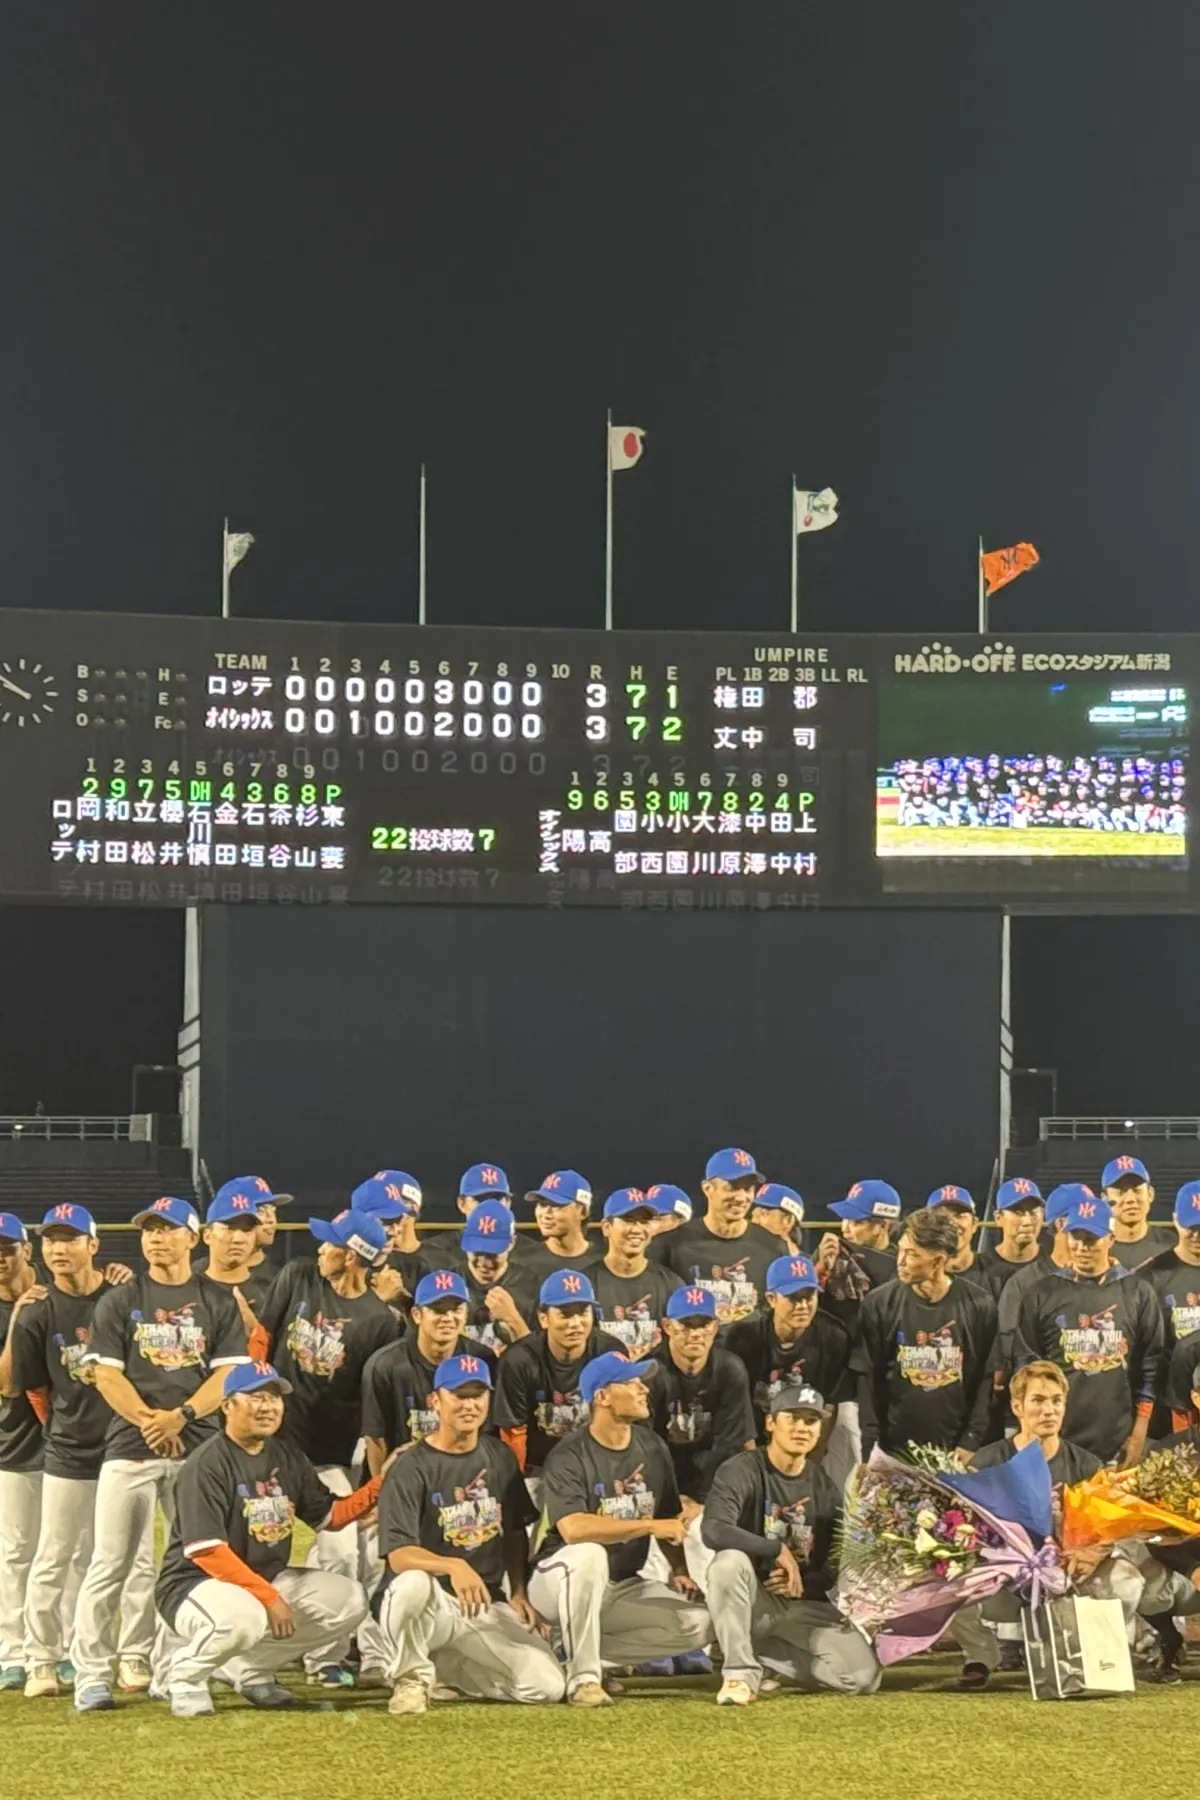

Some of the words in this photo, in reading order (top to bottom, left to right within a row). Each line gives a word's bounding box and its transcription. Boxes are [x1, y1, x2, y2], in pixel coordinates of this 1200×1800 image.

[215, 654, 267, 670] TEAM
[754, 648, 828, 662] UMPIRE
[1021, 653, 1171, 672] ECOスタジアム新潟
[77, 665, 88, 678] B
[158, 668, 170, 681] H
[291, 657, 300, 672] 1
[320, 658, 331, 672] 2
[351, 658, 361, 673] 3
[380, 660, 391, 674] 4
[409, 660, 420, 675] 5
[438, 661, 450, 675] 6
[468, 662, 479, 677] 7
[497, 663, 508, 677] 8
[526, 663, 537, 678] 9
[551, 664, 570, 678] 10
[590, 665, 602, 680] R
[631, 665, 642, 680] H
[667, 666, 678, 680] E
[716, 666, 736, 680] PL
[744, 667, 762, 680] 1B
[768, 667, 790, 681] 2B
[795, 668, 815, 682] 3B
[822, 668, 840, 682] LL
[847, 668, 868, 682] RL
[77, 689, 88, 702] S
[158, 692, 169, 705] E
[208, 676, 272, 696] ロッテ
[286, 676, 306, 700] 0
[315, 676, 335, 701] 0
[346, 678, 366, 702] 0
[375, 678, 395, 703] 0
[404, 678, 424, 704] 0
[434, 680, 454, 704] 3
[463, 680, 484, 705] 0
[492, 681, 512, 706] 0
[522, 682, 542, 706] 0
[586, 684, 606, 708] 3
[626, 684, 646, 708] 7
[668, 684, 677, 708] 1
[155, 716, 172, 729] Fc
[285, 708, 305, 732] 0
[315, 709, 334, 734] 0
[350, 710, 360, 734] 1
[375, 710, 395, 735] 0
[404, 711, 424, 736] 0
[434, 712, 454, 736] 2
[463, 712, 483, 737] 0
[492, 714, 512, 738] 0
[522, 714, 542, 738] 0
[586, 716, 606, 740] 3
[626, 716, 646, 740] 7
[663, 716, 682, 740] 2
[87, 758, 96, 772] 1
[114, 760, 125, 773] 2
[141, 760, 152, 774] 3
[168, 760, 179, 774] 4
[196, 761, 206, 776] 5
[223, 762, 234, 776] 6
[250, 764, 261, 777] 7
[276, 764, 288, 778] 8
[304, 765, 314, 778] 9
[571, 772, 580, 785] 1
[596, 772, 607, 786] 2
[623, 772, 633, 786] 3
[648, 772, 658, 786] 4
[674, 772, 684, 786] 5
[700, 773, 710, 786] 6
[726, 774, 736, 787] 7
[752, 774, 762, 787] 8
[778, 774, 788, 788] 9
[82, 778, 98, 798] 2
[110, 778, 126, 798] 9
[138, 780, 154, 799] 7
[166, 780, 181, 800] 5
[190, 781, 211, 800] DH
[220, 782, 235, 801] 4
[247, 782, 262, 802] 3
[274, 784, 289, 802] 6
[300, 784, 316, 803] 8
[326, 785, 342, 804] P
[568, 790, 583, 810] 9
[594, 791, 609, 810] 6
[620, 791, 634, 810] 5
[646, 791, 660, 810] 3
[670, 792, 690, 811] DH
[697, 792, 712, 811] 7
[724, 792, 738, 812] 8
[749, 792, 764, 812] 2
[774, 792, 790, 812] 4
[799, 792, 814, 812] P
[51, 800, 76, 860] ロッテ
[372, 828, 407, 850] 22
[479, 829, 494, 851] 7
